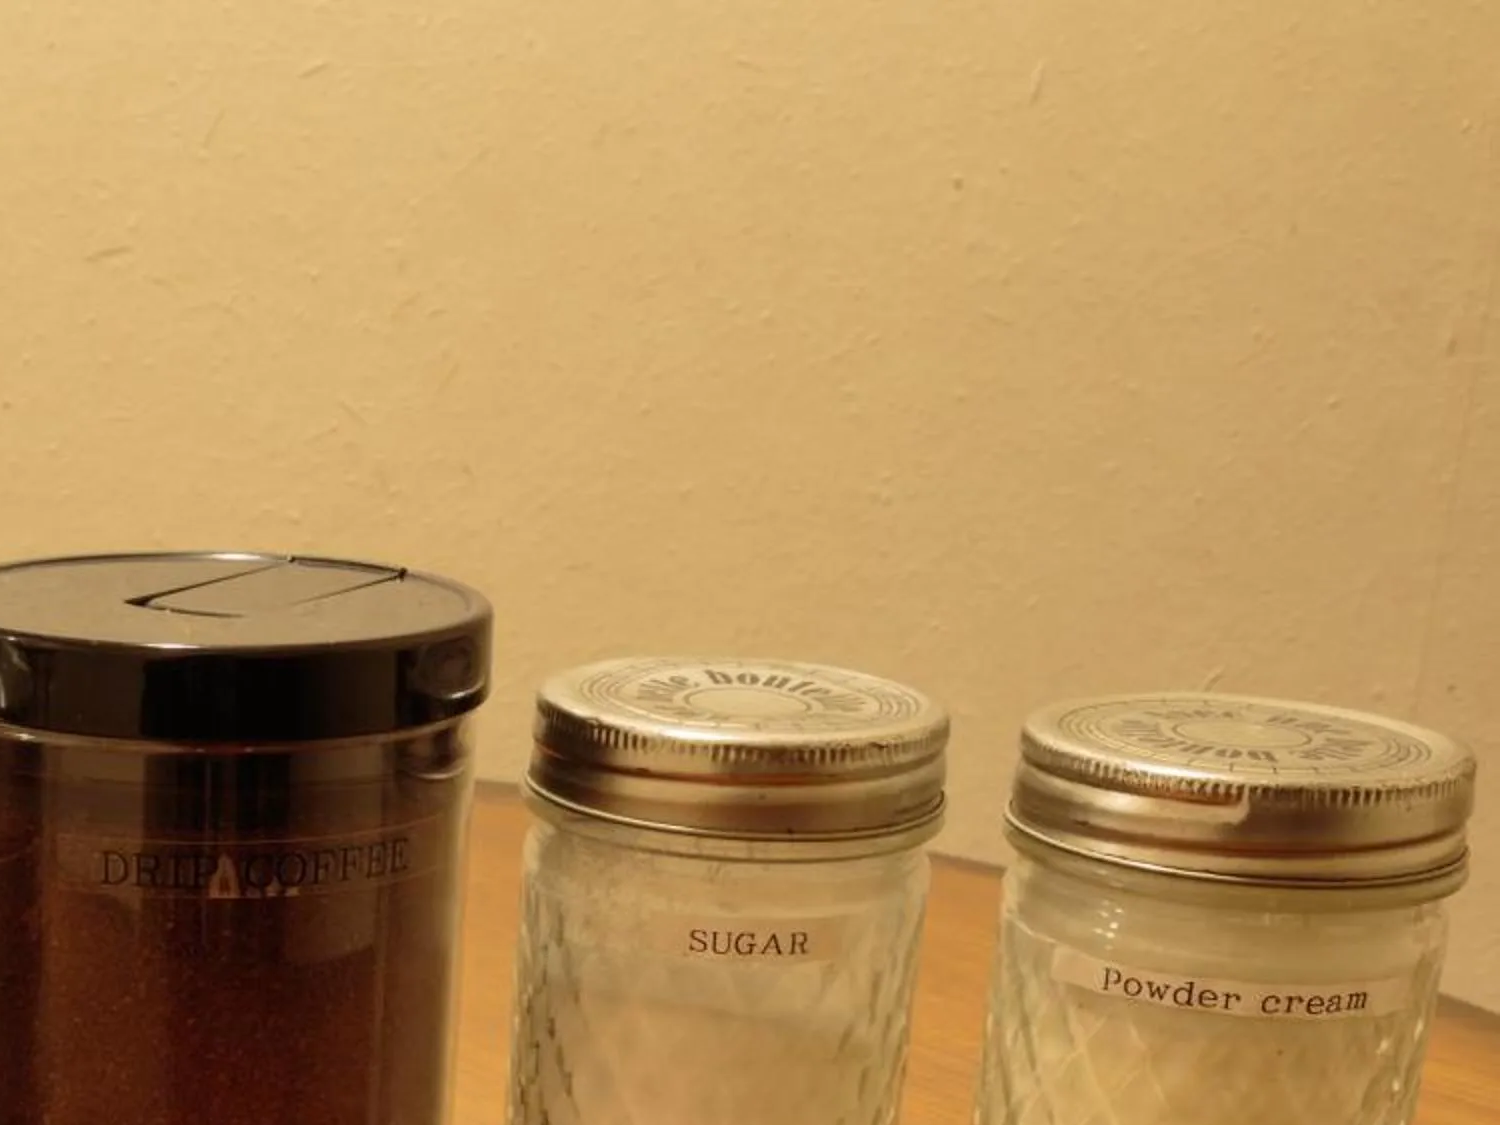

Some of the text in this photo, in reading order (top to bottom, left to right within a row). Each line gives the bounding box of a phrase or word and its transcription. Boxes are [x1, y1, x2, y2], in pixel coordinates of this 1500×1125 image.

[99, 838, 409, 888] DRIP COFFEE
[688, 929, 809, 956] SUGAR
[1102, 966, 1368, 1015] Powder cream
